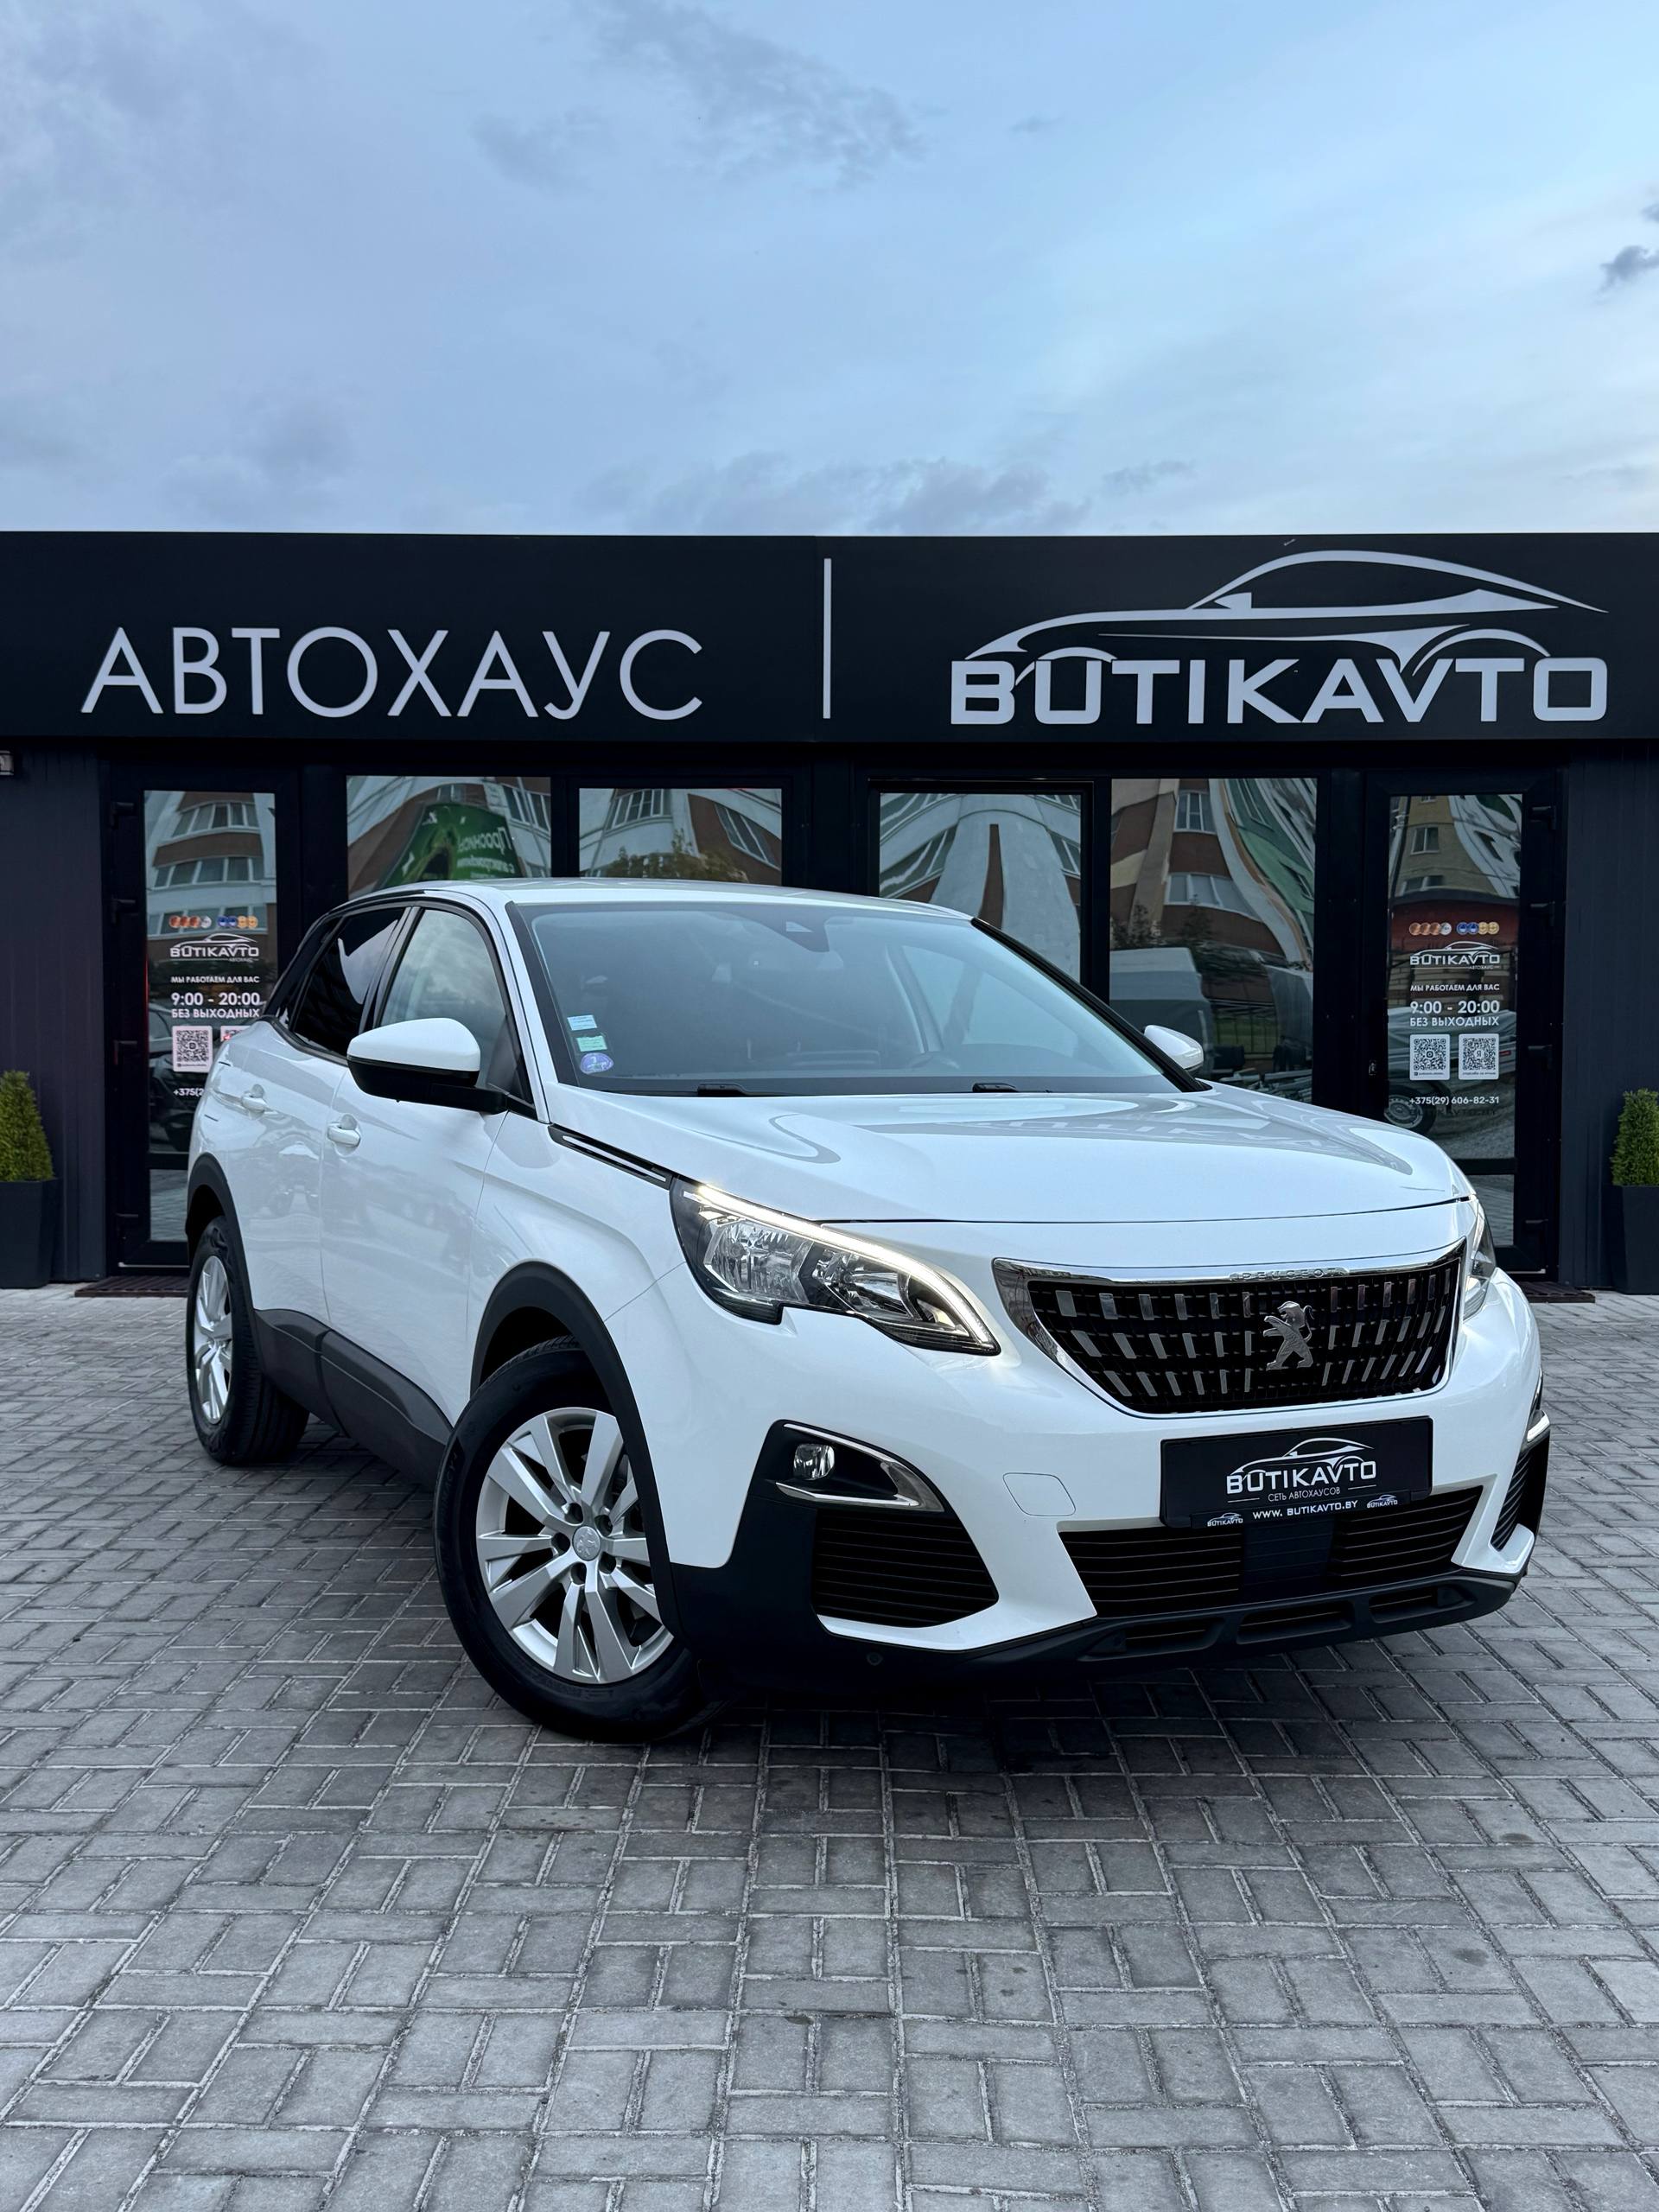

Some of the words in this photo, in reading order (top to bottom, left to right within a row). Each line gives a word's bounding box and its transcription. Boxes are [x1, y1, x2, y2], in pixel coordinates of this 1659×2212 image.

[81, 626, 702, 721] АВТОХАУС
[951, 658, 1608, 724] BUTIKAVTO
[170, 947, 259, 957] BUTIKAVTO
[1410, 954, 1500, 965] BUTIKAVTO
[1466, 983, 1483, 992] ДЛЯ
[171, 992, 204, 1006] 9:00
[219, 992, 260, 1006] 20:00
[1410, 1001, 1442, 1014] 9:00
[1458, 1000, 1500, 1014] 20:00
[171, 1008, 190, 1019] БЕЗ
[193, 1008, 260, 1019] ВЫХОДНЫХ
[1409, 1017, 1428, 1027] БЕЗ
[1431, 1016, 1500, 1027] ВЫХОДНЫХ
[173, 1088, 205, 1096] +375(2
[1409, 1096, 1450, 1106] +375(29)
[1451, 1095, 1500, 1105] 606-82-31
[1226, 1461, 1376, 1495] BUTIKAVTO
[1268, 1492, 1287, 1502] СЕТЬ
[1288, 1486, 1341, 1500] АВТОХАУСОВ
[1253, 1509, 1283, 1519] WWW.
[1287, 1500, 1358, 1516] BUTIKAVTO.BY
[1367, 1499, 1398, 1509] BUTIKAVTO
[1207, 1517, 1243, 1527] BUTIKAVTO
